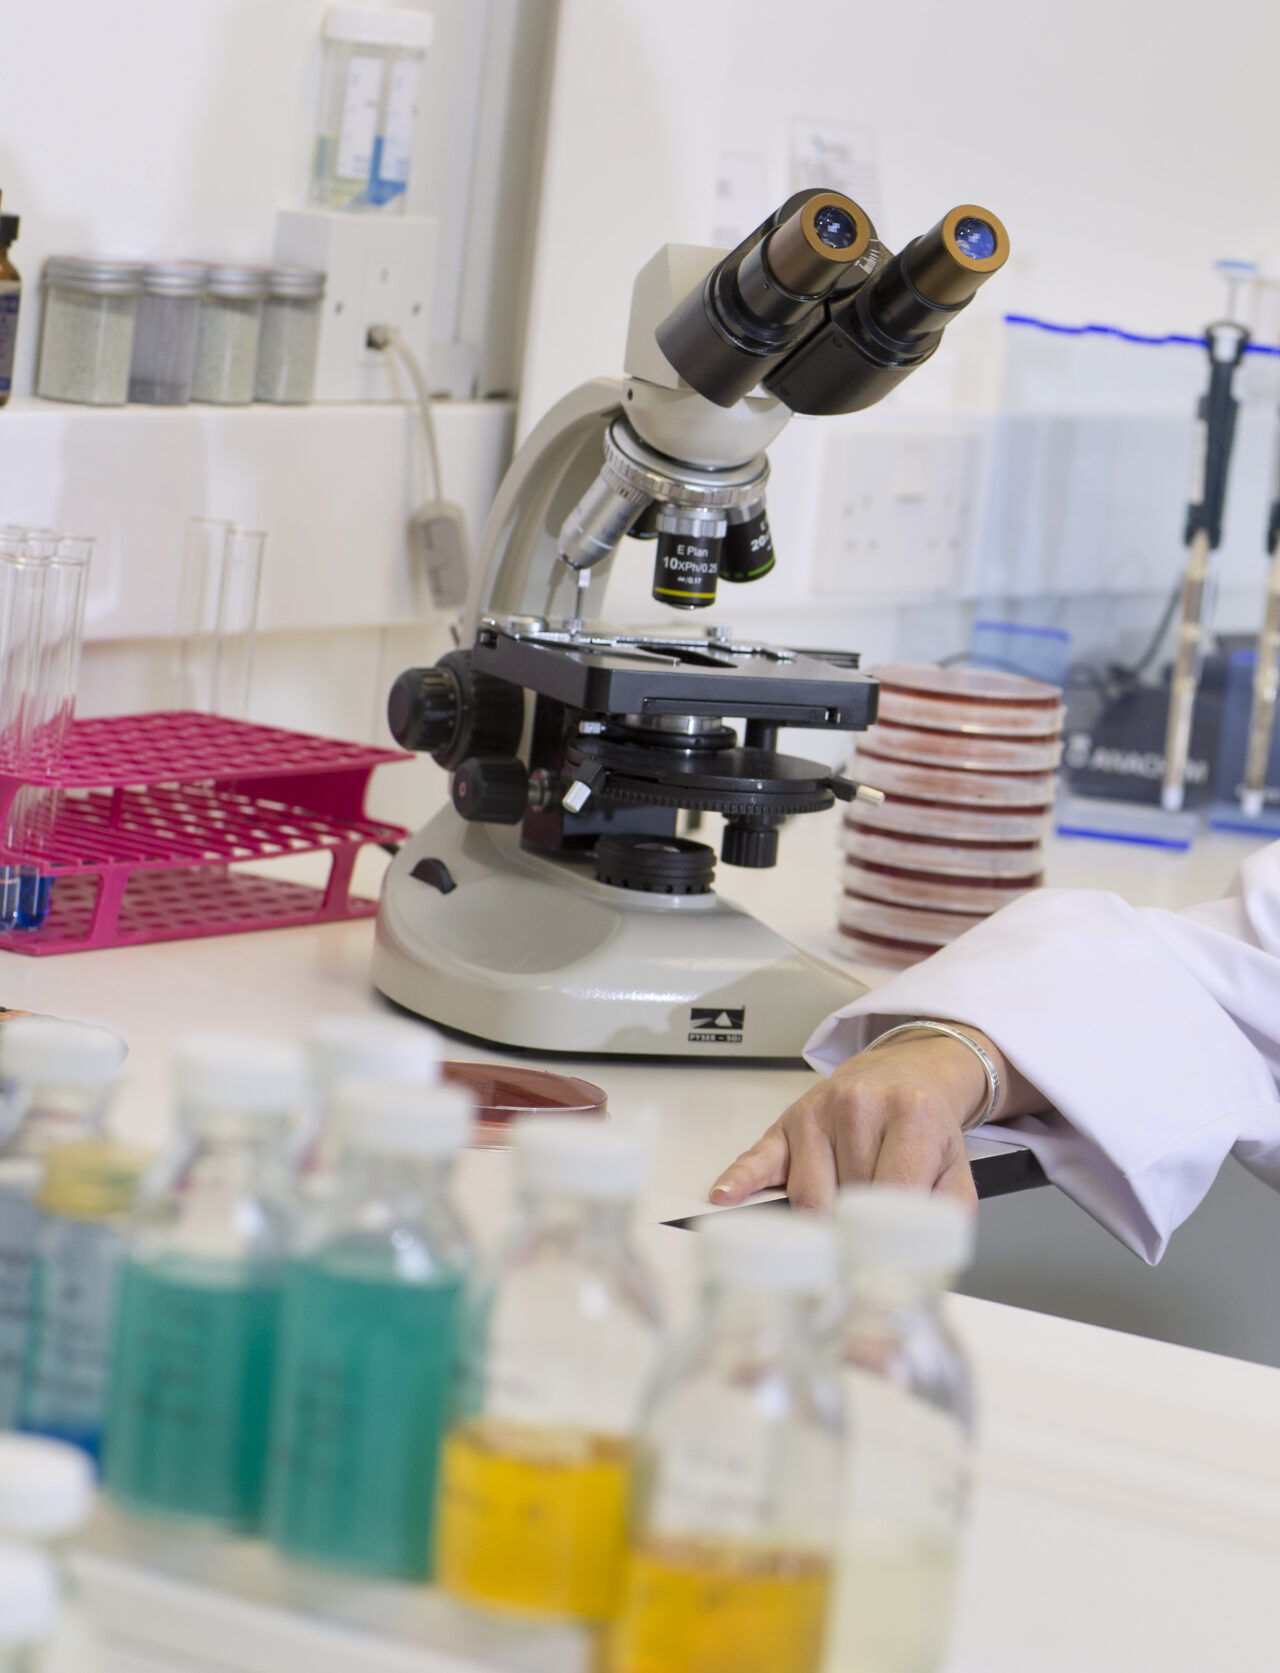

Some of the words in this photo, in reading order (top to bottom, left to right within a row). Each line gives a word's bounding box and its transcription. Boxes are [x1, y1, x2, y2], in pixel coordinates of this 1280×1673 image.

[677, 544, 685, 555] E
[687, 545, 709, 557] Plan
[1090, 746, 1209, 784] ANACHM
